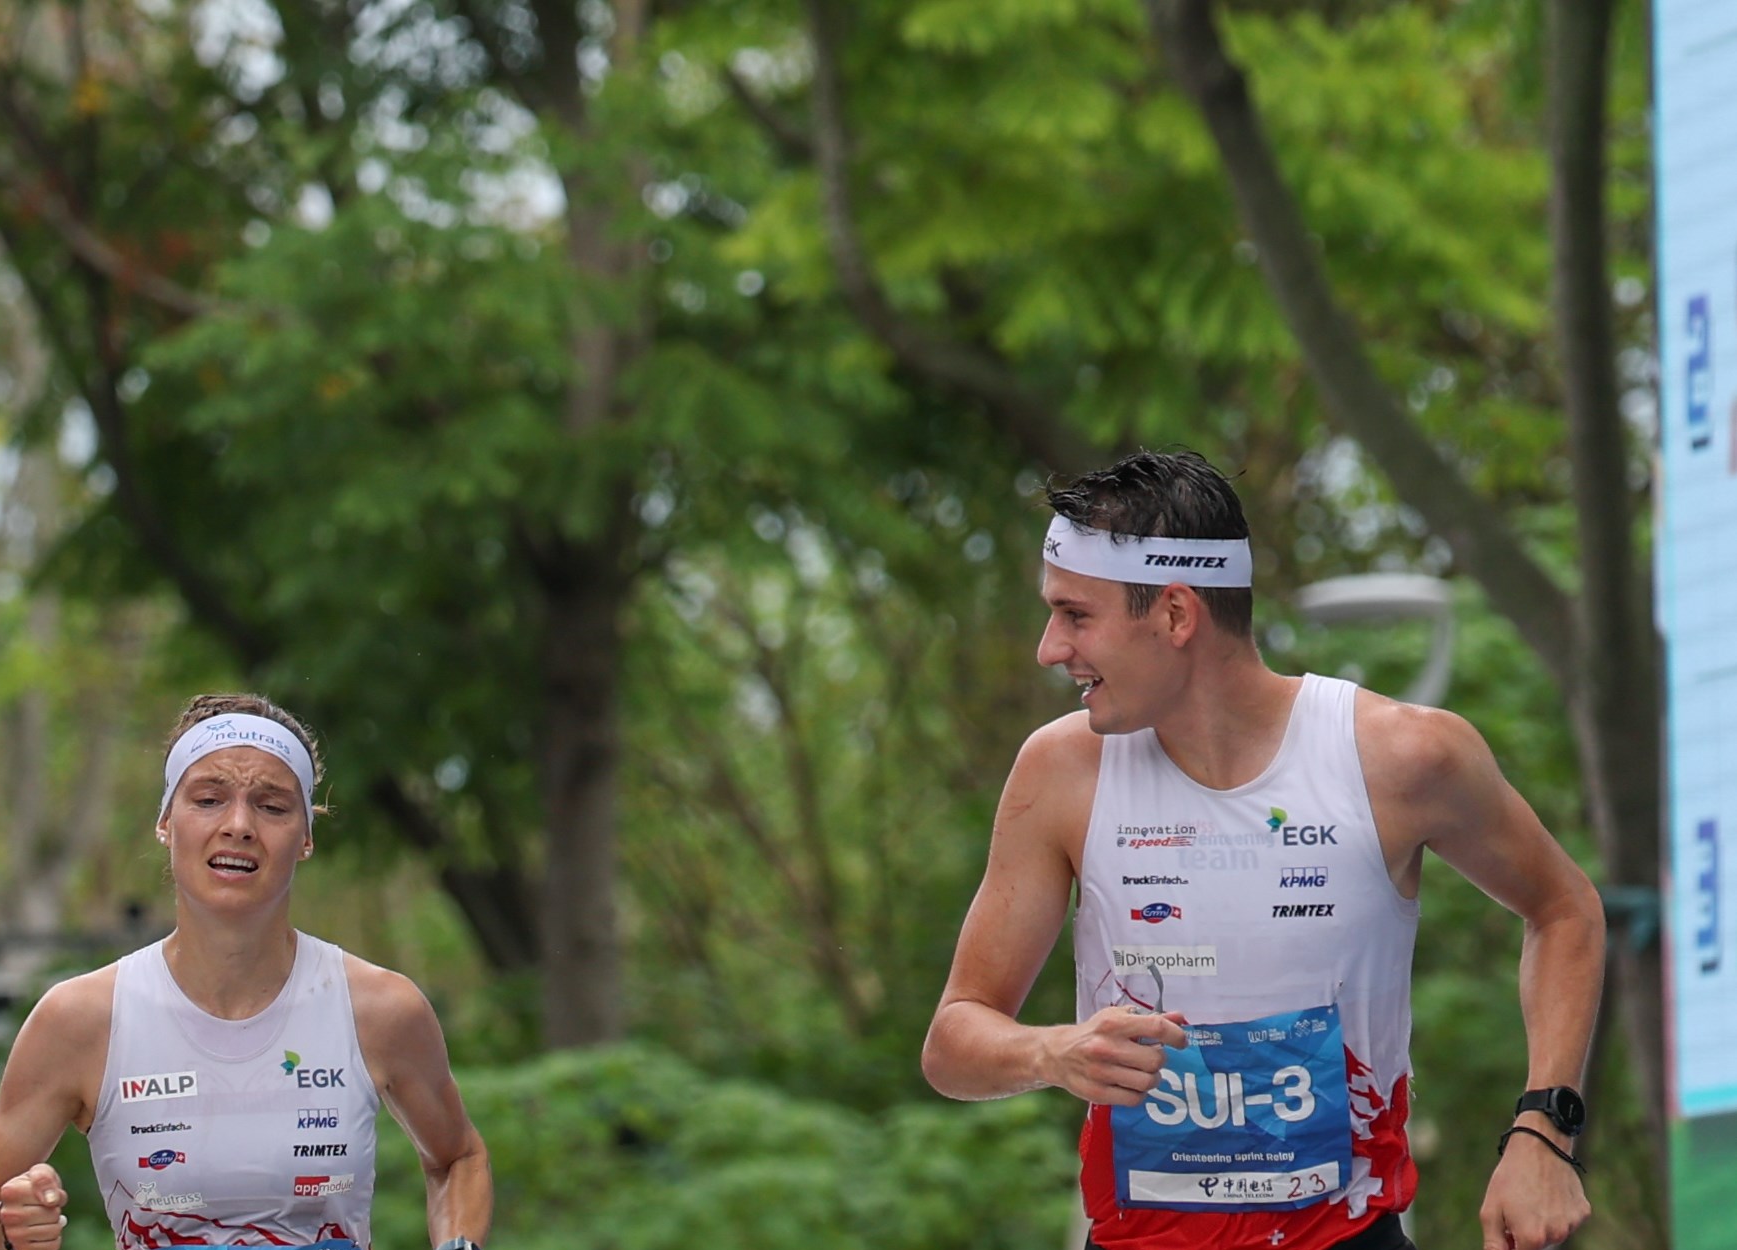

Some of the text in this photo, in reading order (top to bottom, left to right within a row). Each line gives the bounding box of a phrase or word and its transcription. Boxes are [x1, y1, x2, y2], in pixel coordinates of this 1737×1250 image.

[1144, 554, 1228, 568] TRIMTEX
[215, 731, 291, 755] neutrass
[1117, 824, 1197, 837] innovation
[1283, 825, 1338, 846] EGK
[1128, 836, 1170, 849] speed
[1280, 875, 1326, 889] KPMG
[1272, 904, 1336, 918] TRIMTEX
[297, 1068, 346, 1089] EGK
[122, 1076, 195, 1099] INALP
[1145, 1065, 1316, 1130] SUI-3
[297, 1116, 338, 1129] KPMG
[293, 1144, 348, 1158] TRIMTEX
[1171, 1152, 1232, 1163] Orienteering
[1266, 1151, 1295, 1162] Relay
[1223, 1178, 1274, 1192] 中国电信
[148, 1192, 202, 1208] neutrass
